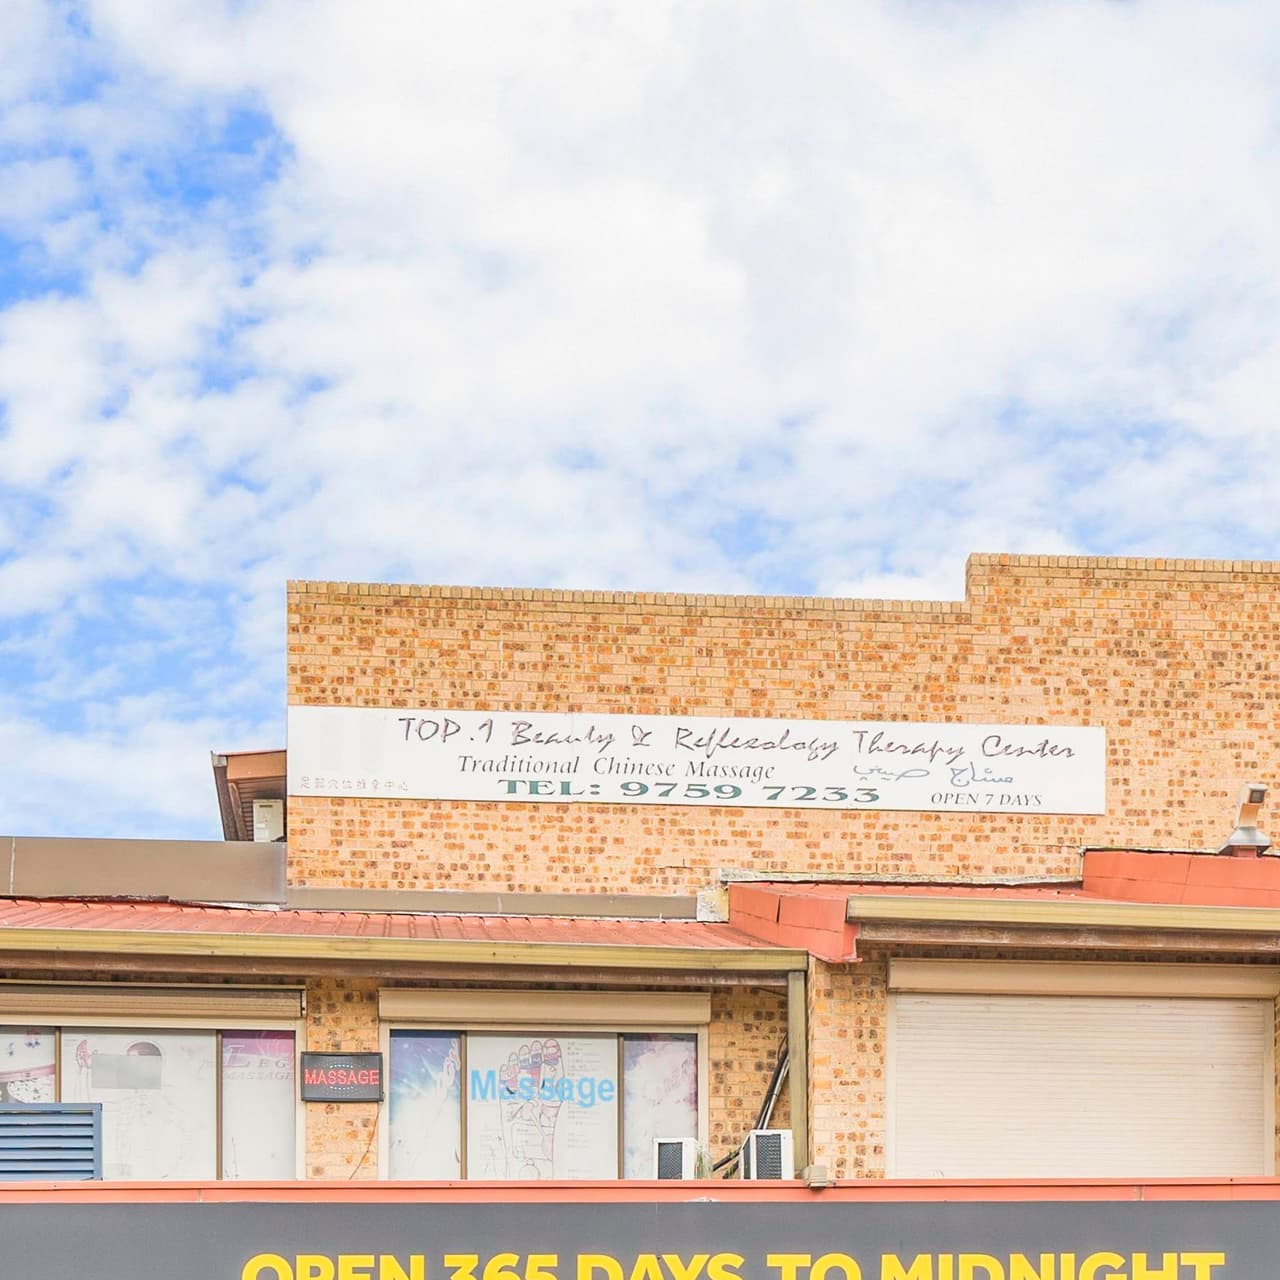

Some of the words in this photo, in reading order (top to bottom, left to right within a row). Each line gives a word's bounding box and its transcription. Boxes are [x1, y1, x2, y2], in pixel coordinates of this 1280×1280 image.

[511, 721, 616, 754] Beauty
[631, 725, 653, 747] &
[852, 730, 966, 764] Therapy
[981, 735, 1077, 758] Center
[458, 755, 580, 775] Traditional
[593, 757, 683, 778] Chinese
[684, 760, 776, 780] Massage
[498, 779, 602, 797] TEL:
[620, 781, 743, 800] 9759
[762, 785, 881, 803] 7233
[930, 790, 979, 806] OPEN
[985, 792, 995, 806] 7
[998, 792, 1043, 807] DAYS
[304, 1068, 380, 1085] MASSAGE
[470, 1070, 615, 1108] Massage
